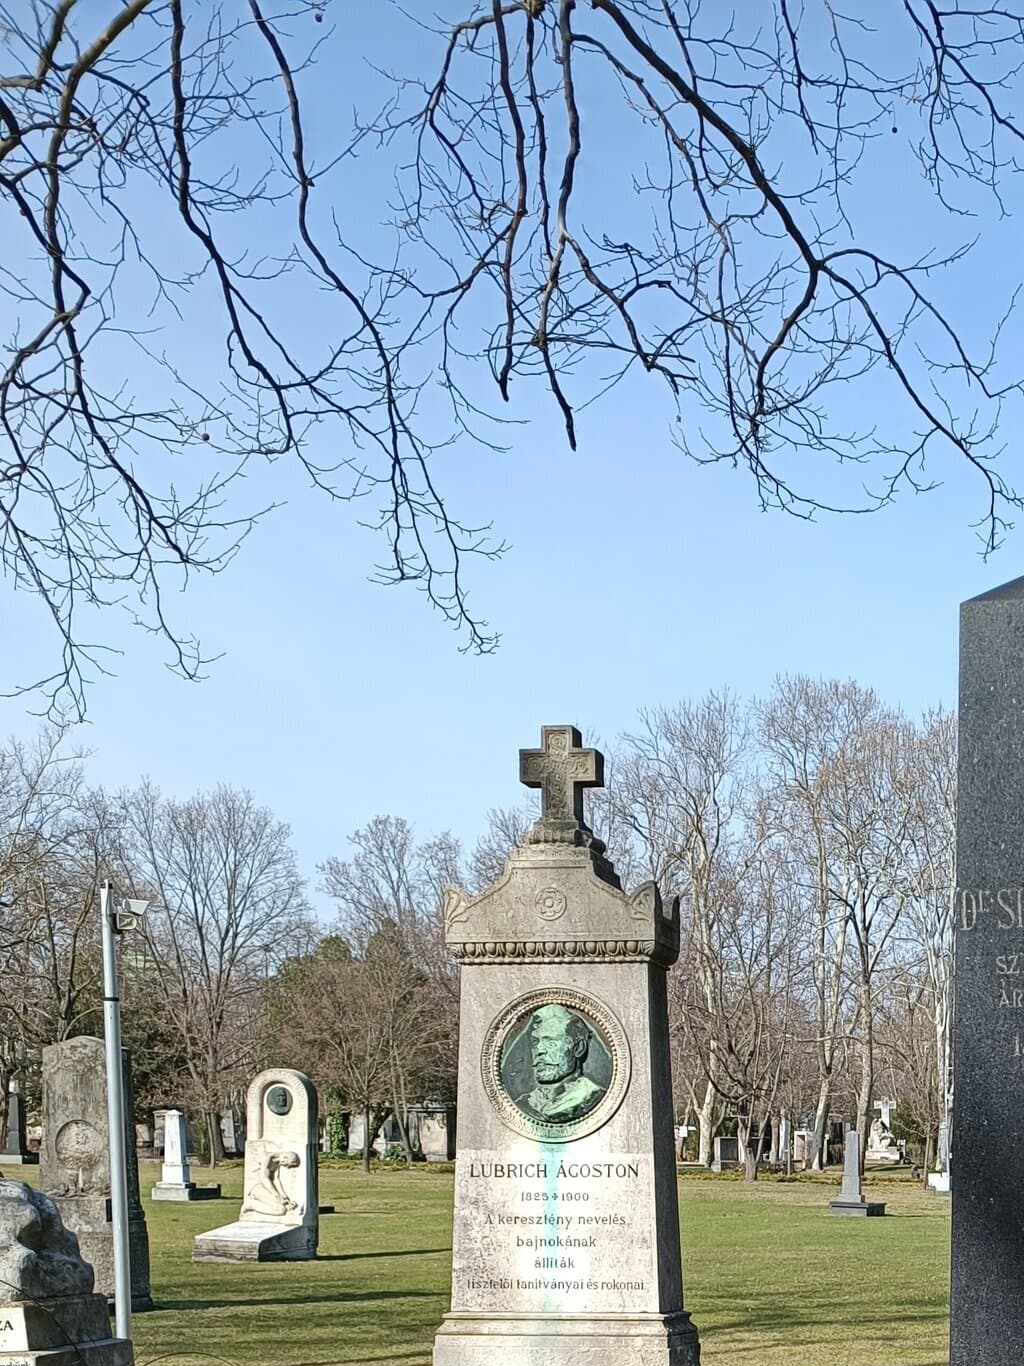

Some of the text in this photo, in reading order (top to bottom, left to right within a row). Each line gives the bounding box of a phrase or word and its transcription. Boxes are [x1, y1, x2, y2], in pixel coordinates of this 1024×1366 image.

[470, 1159, 640, 1178] LUBRICH ÁGOSTON
[561, 1191, 590, 1202] 1900
[498, 1213, 573, 1230] keresztény
[578, 1213, 627, 1225] nevelés
[516, 1235, 597, 1251] bajnokának
[586, 1277, 599, 1290] és
